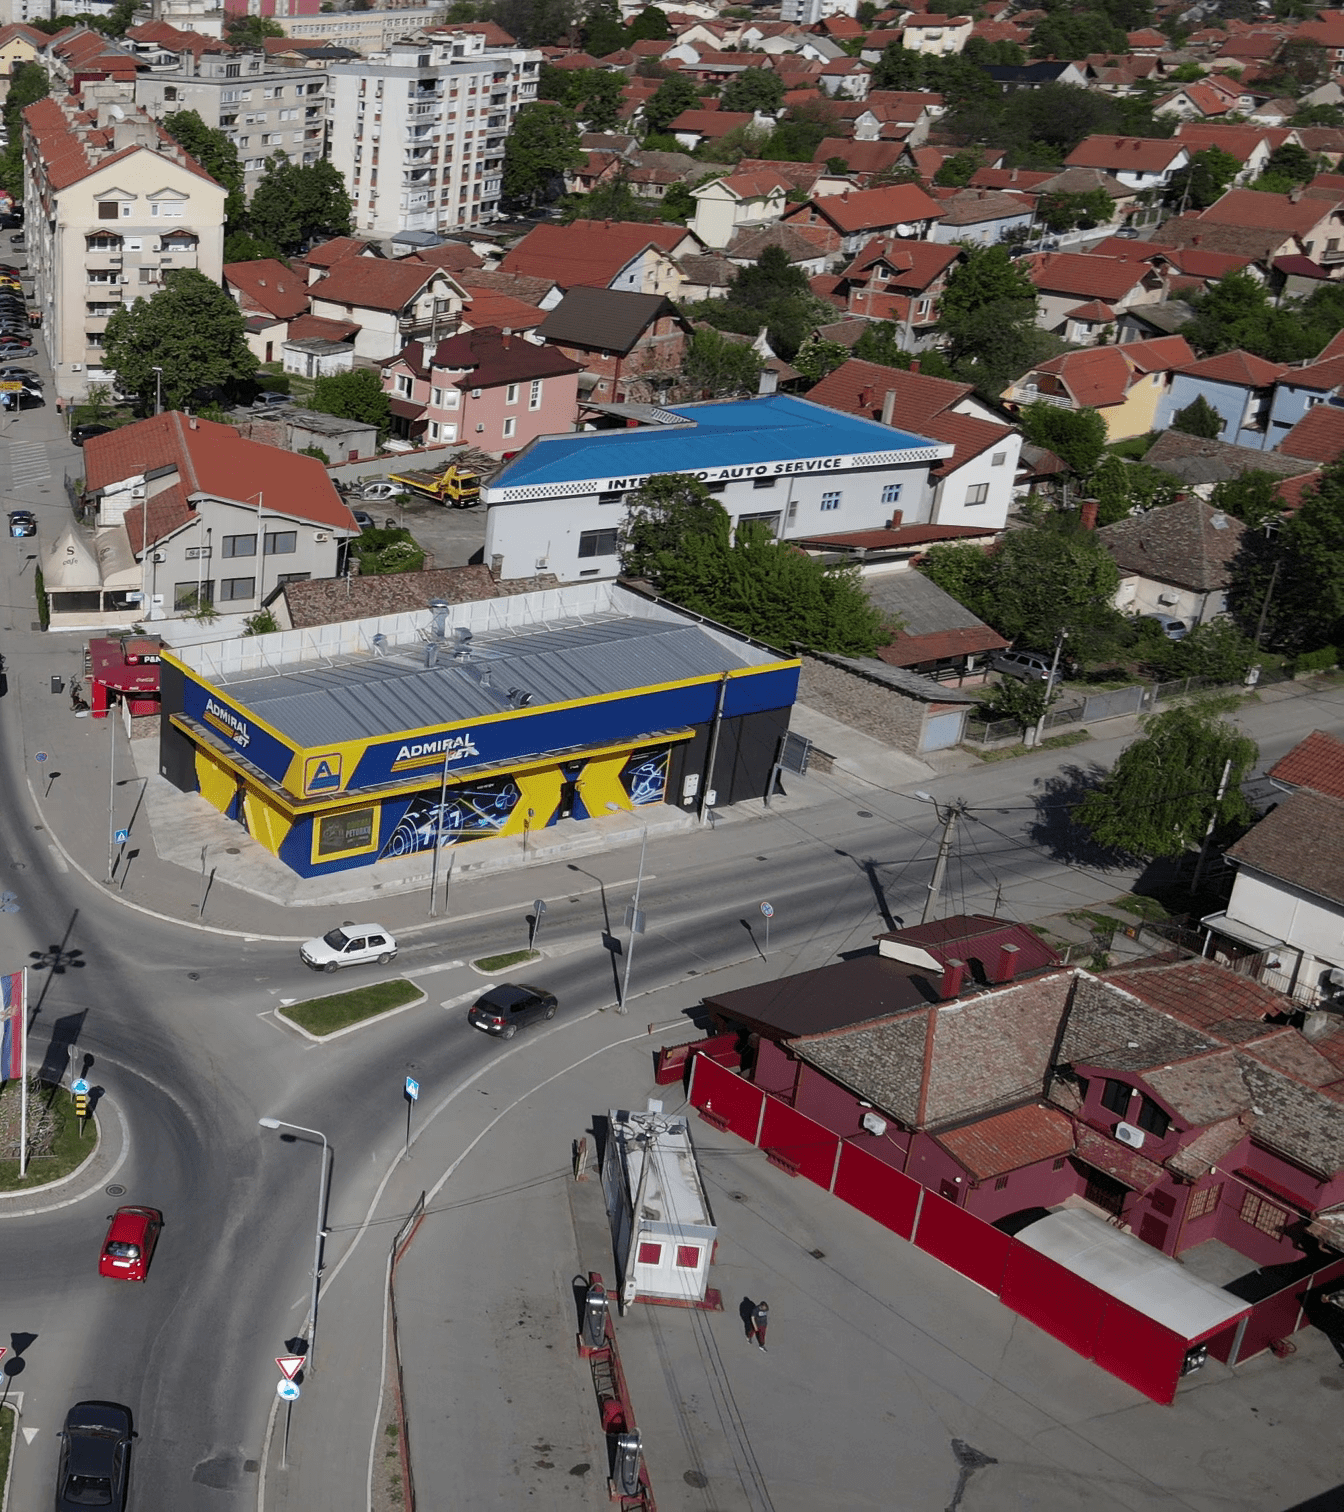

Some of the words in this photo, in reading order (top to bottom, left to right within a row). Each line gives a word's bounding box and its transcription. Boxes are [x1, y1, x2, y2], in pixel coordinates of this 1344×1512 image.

[608, 477, 648, 489] INTE
[774, 459, 841, 473] SERVICE
[66, 546, 74, 555] S
[206, 698, 250, 740] ADMIRAL
[396, 733, 475, 761] ADMIRAL
